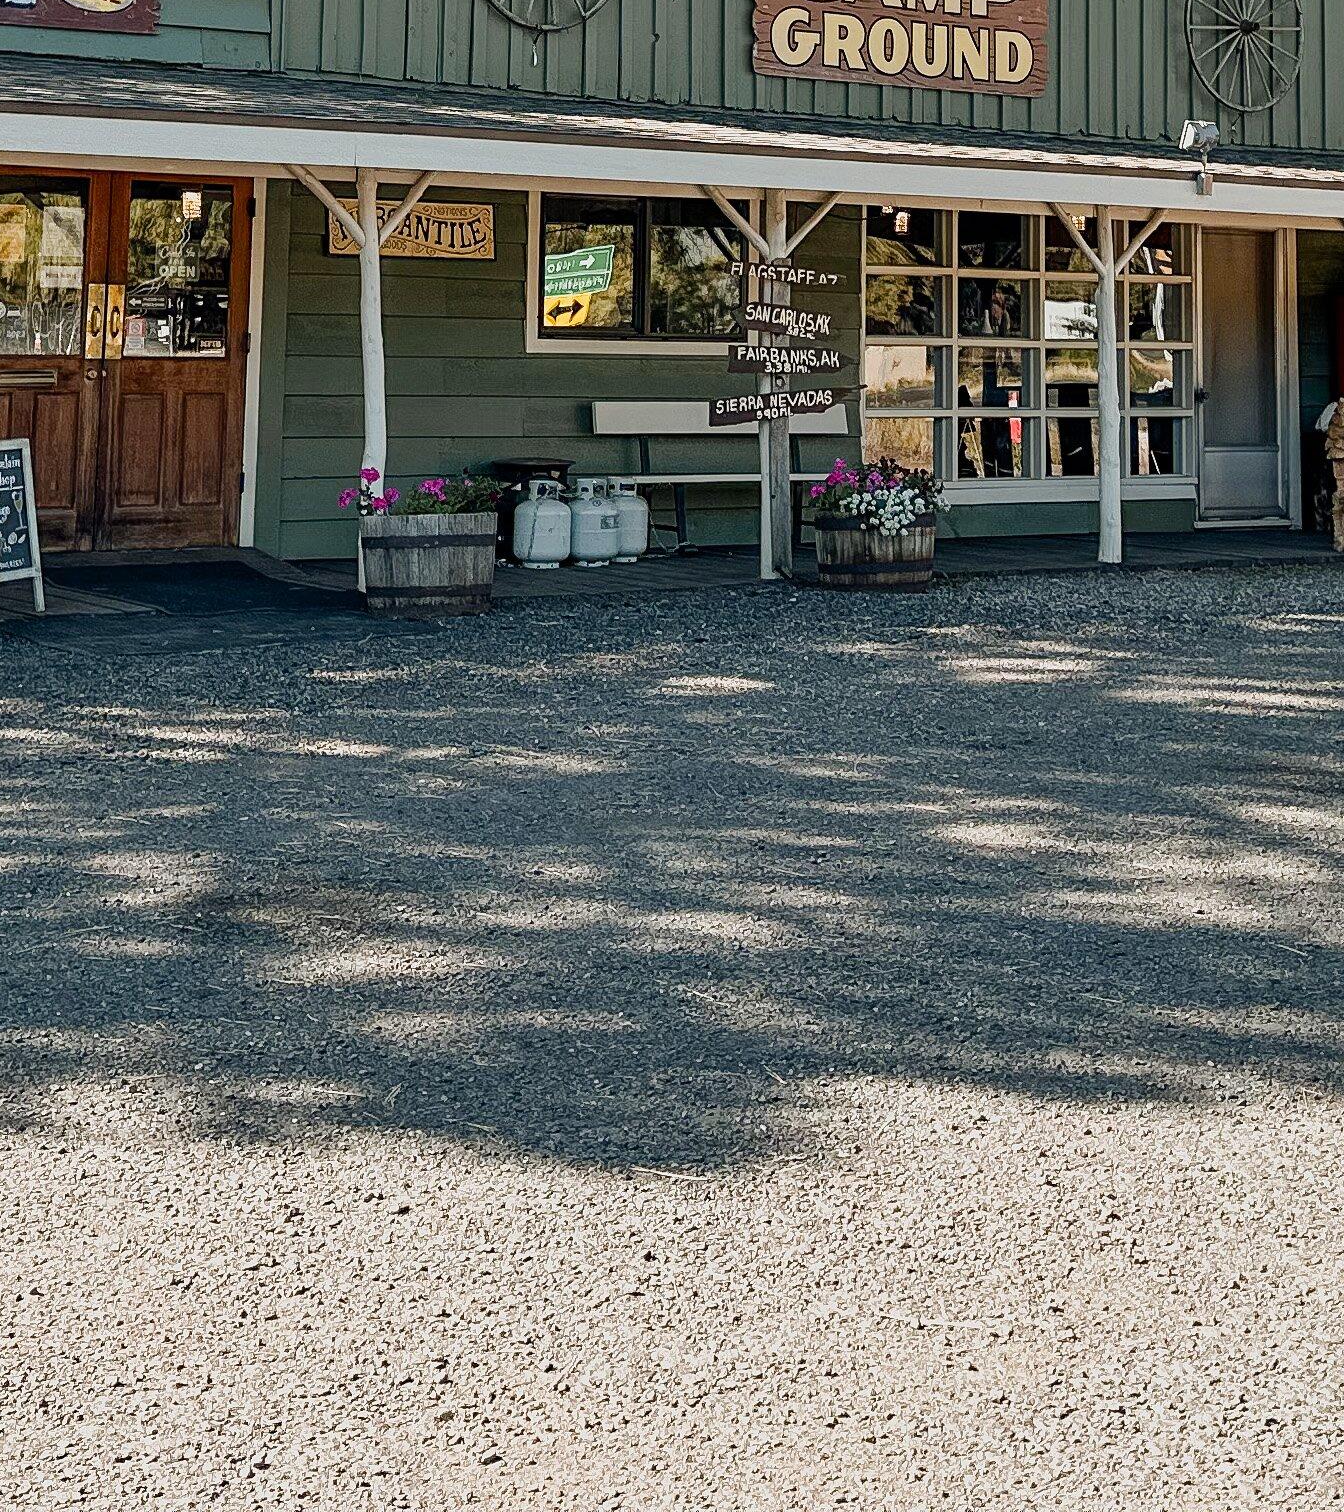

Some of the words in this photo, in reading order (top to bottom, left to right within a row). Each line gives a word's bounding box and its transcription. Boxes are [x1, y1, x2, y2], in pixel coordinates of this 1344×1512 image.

[770, 6, 1034, 84] GROUND
[745, 304, 771, 323] SAN
[716, 395, 764, 414] SIERRA
[770, 390, 833, 407] NEVADAS
